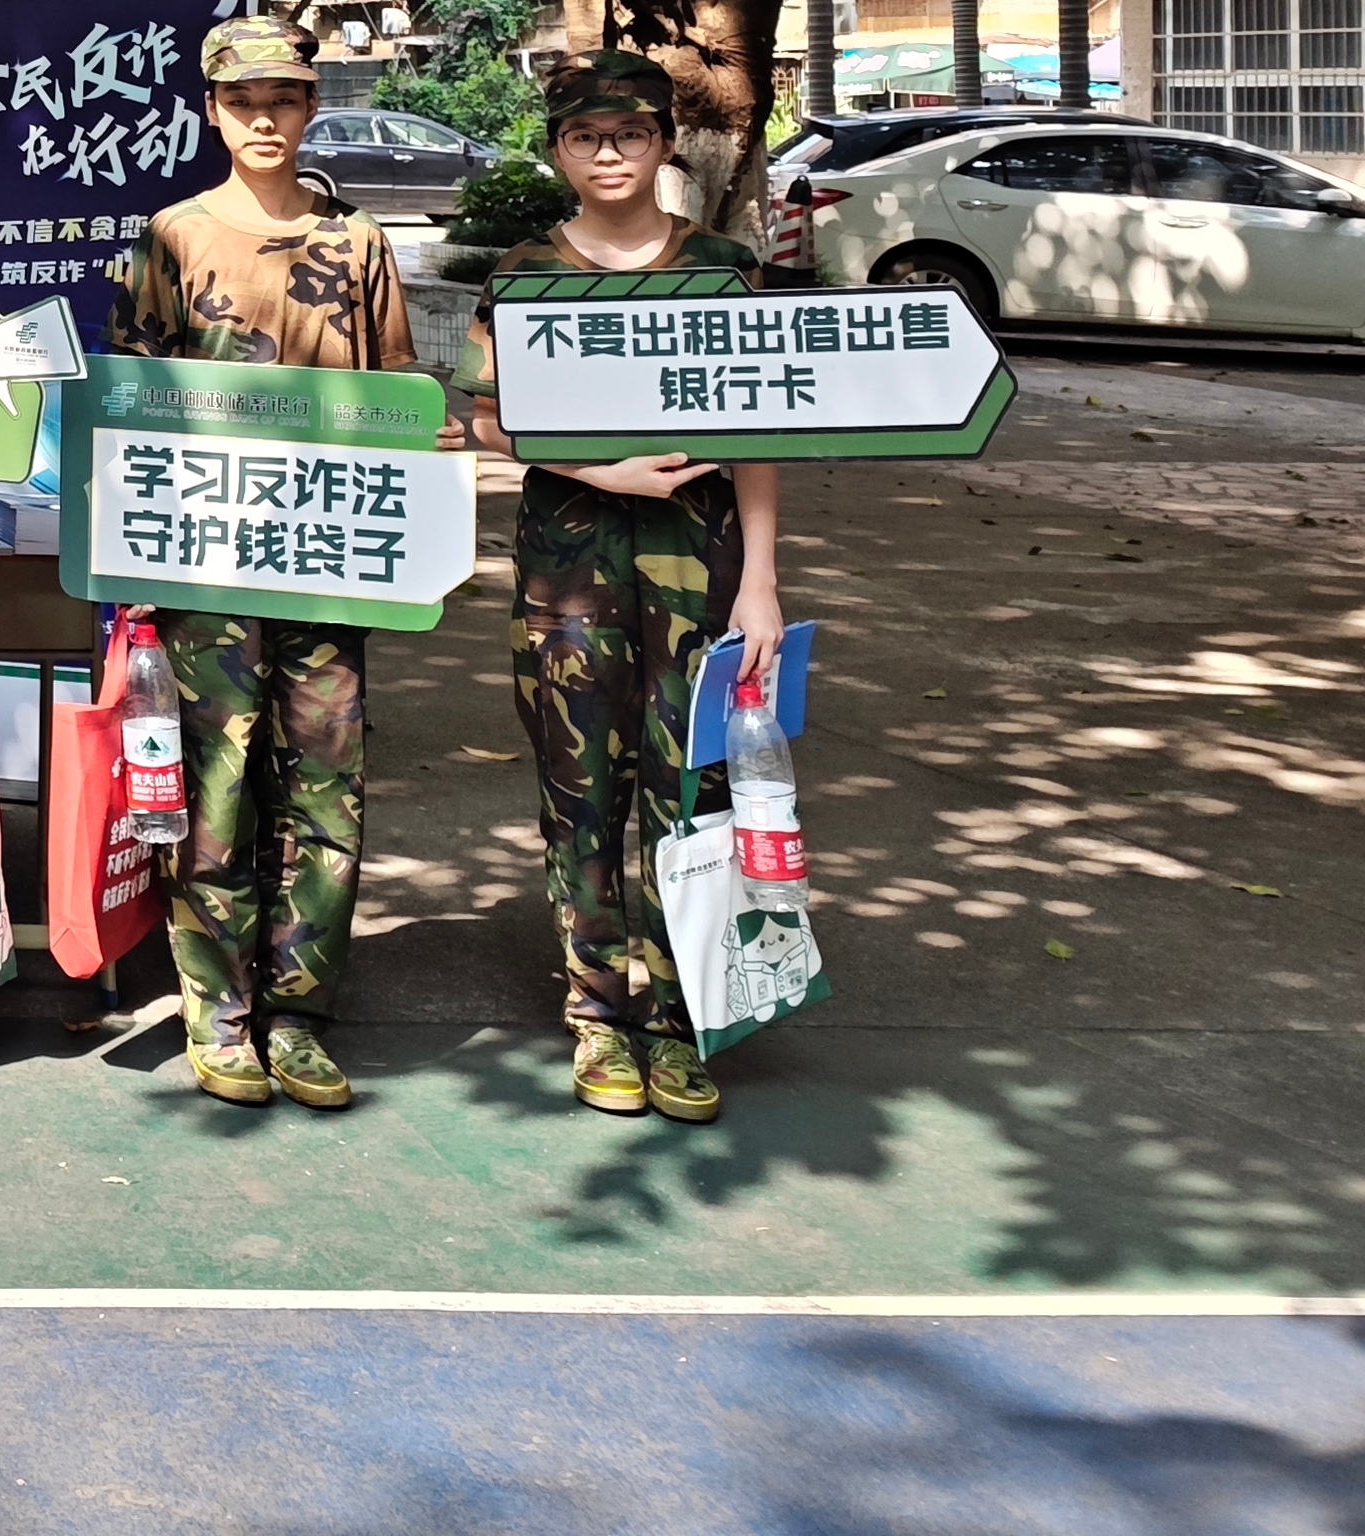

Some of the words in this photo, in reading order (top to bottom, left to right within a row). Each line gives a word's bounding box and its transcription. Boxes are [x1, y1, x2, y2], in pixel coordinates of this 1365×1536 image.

[18, 94, 201, 187] 在行动
[526, 302, 951, 359] 不要出租出借出售
[142, 385, 312, 416] 中国邮政储蓄银行
[333, 402, 420, 425] 韶关市分行
[659, 364, 817, 413] 银行卡
[123, 444, 408, 520] 学习反诈法
[122, 509, 406, 584] 守护钱袋子
